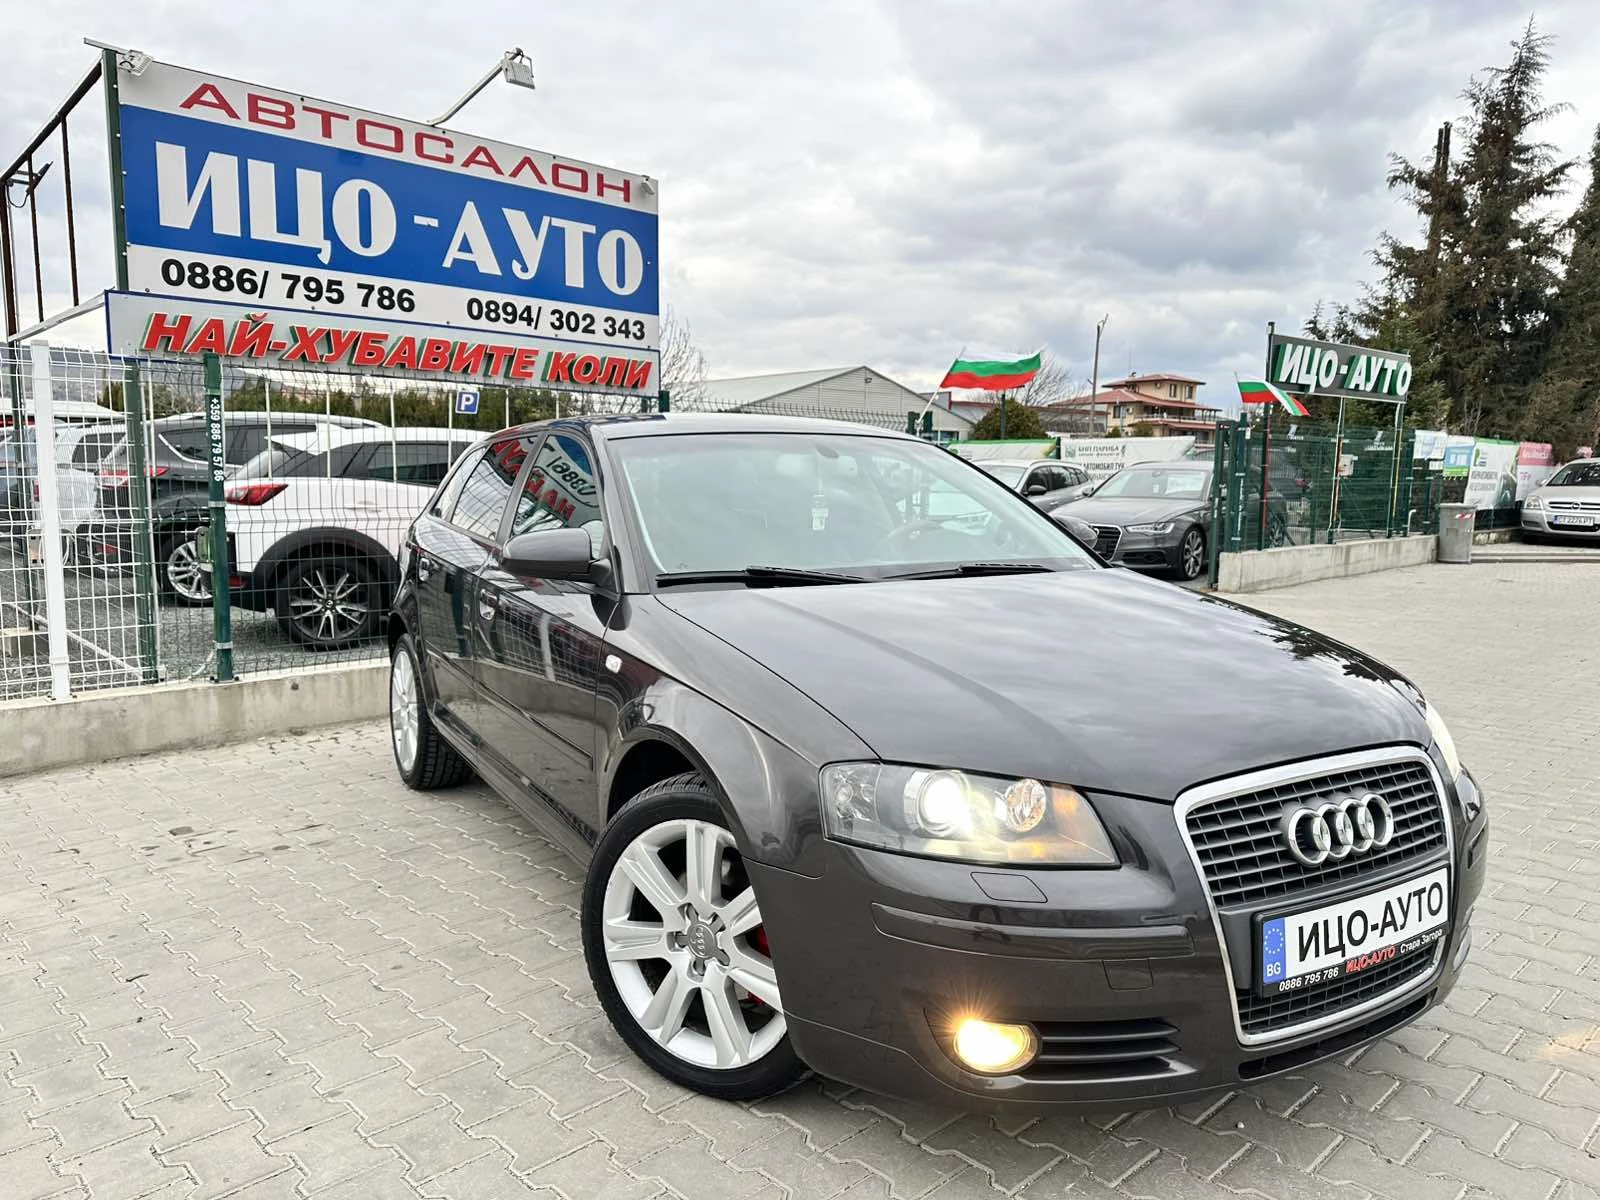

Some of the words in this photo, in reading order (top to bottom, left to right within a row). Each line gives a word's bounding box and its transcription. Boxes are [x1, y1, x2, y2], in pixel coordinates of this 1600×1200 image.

[179, 83, 630, 203] АВТОСАЛОН
[161, 258, 269, 299] 0886/
[281, 273, 345, 305] 795
[357, 282, 415, 313] 786
[466, 297, 542, 330] 0894/
[550, 308, 596, 335] 302
[603, 316, 645, 341] 343
[141, 311, 540, 379] НАЙ-ХУБАВИТЕ
[541, 350, 653, 390] КОЛИ
[210, 398, 221, 421] +359
[460, 394, 474, 412] P
[210, 422, 221, 441] 886
[211, 442, 222, 454] 79
[213, 456, 223, 469] 57
[213, 469, 225, 482] 86
[1298, 881, 1444, 963] ИЦО-АУТО
[1400, 939, 1421, 954] Стара
[1266, 962, 1281, 977] BG
[1346, 944, 1396, 973] ИЦО-АУТО
[1279, 977, 1302, 992] 0886
[1304, 972, 1321, 985] 795
[1323, 967, 1339, 980] 786
